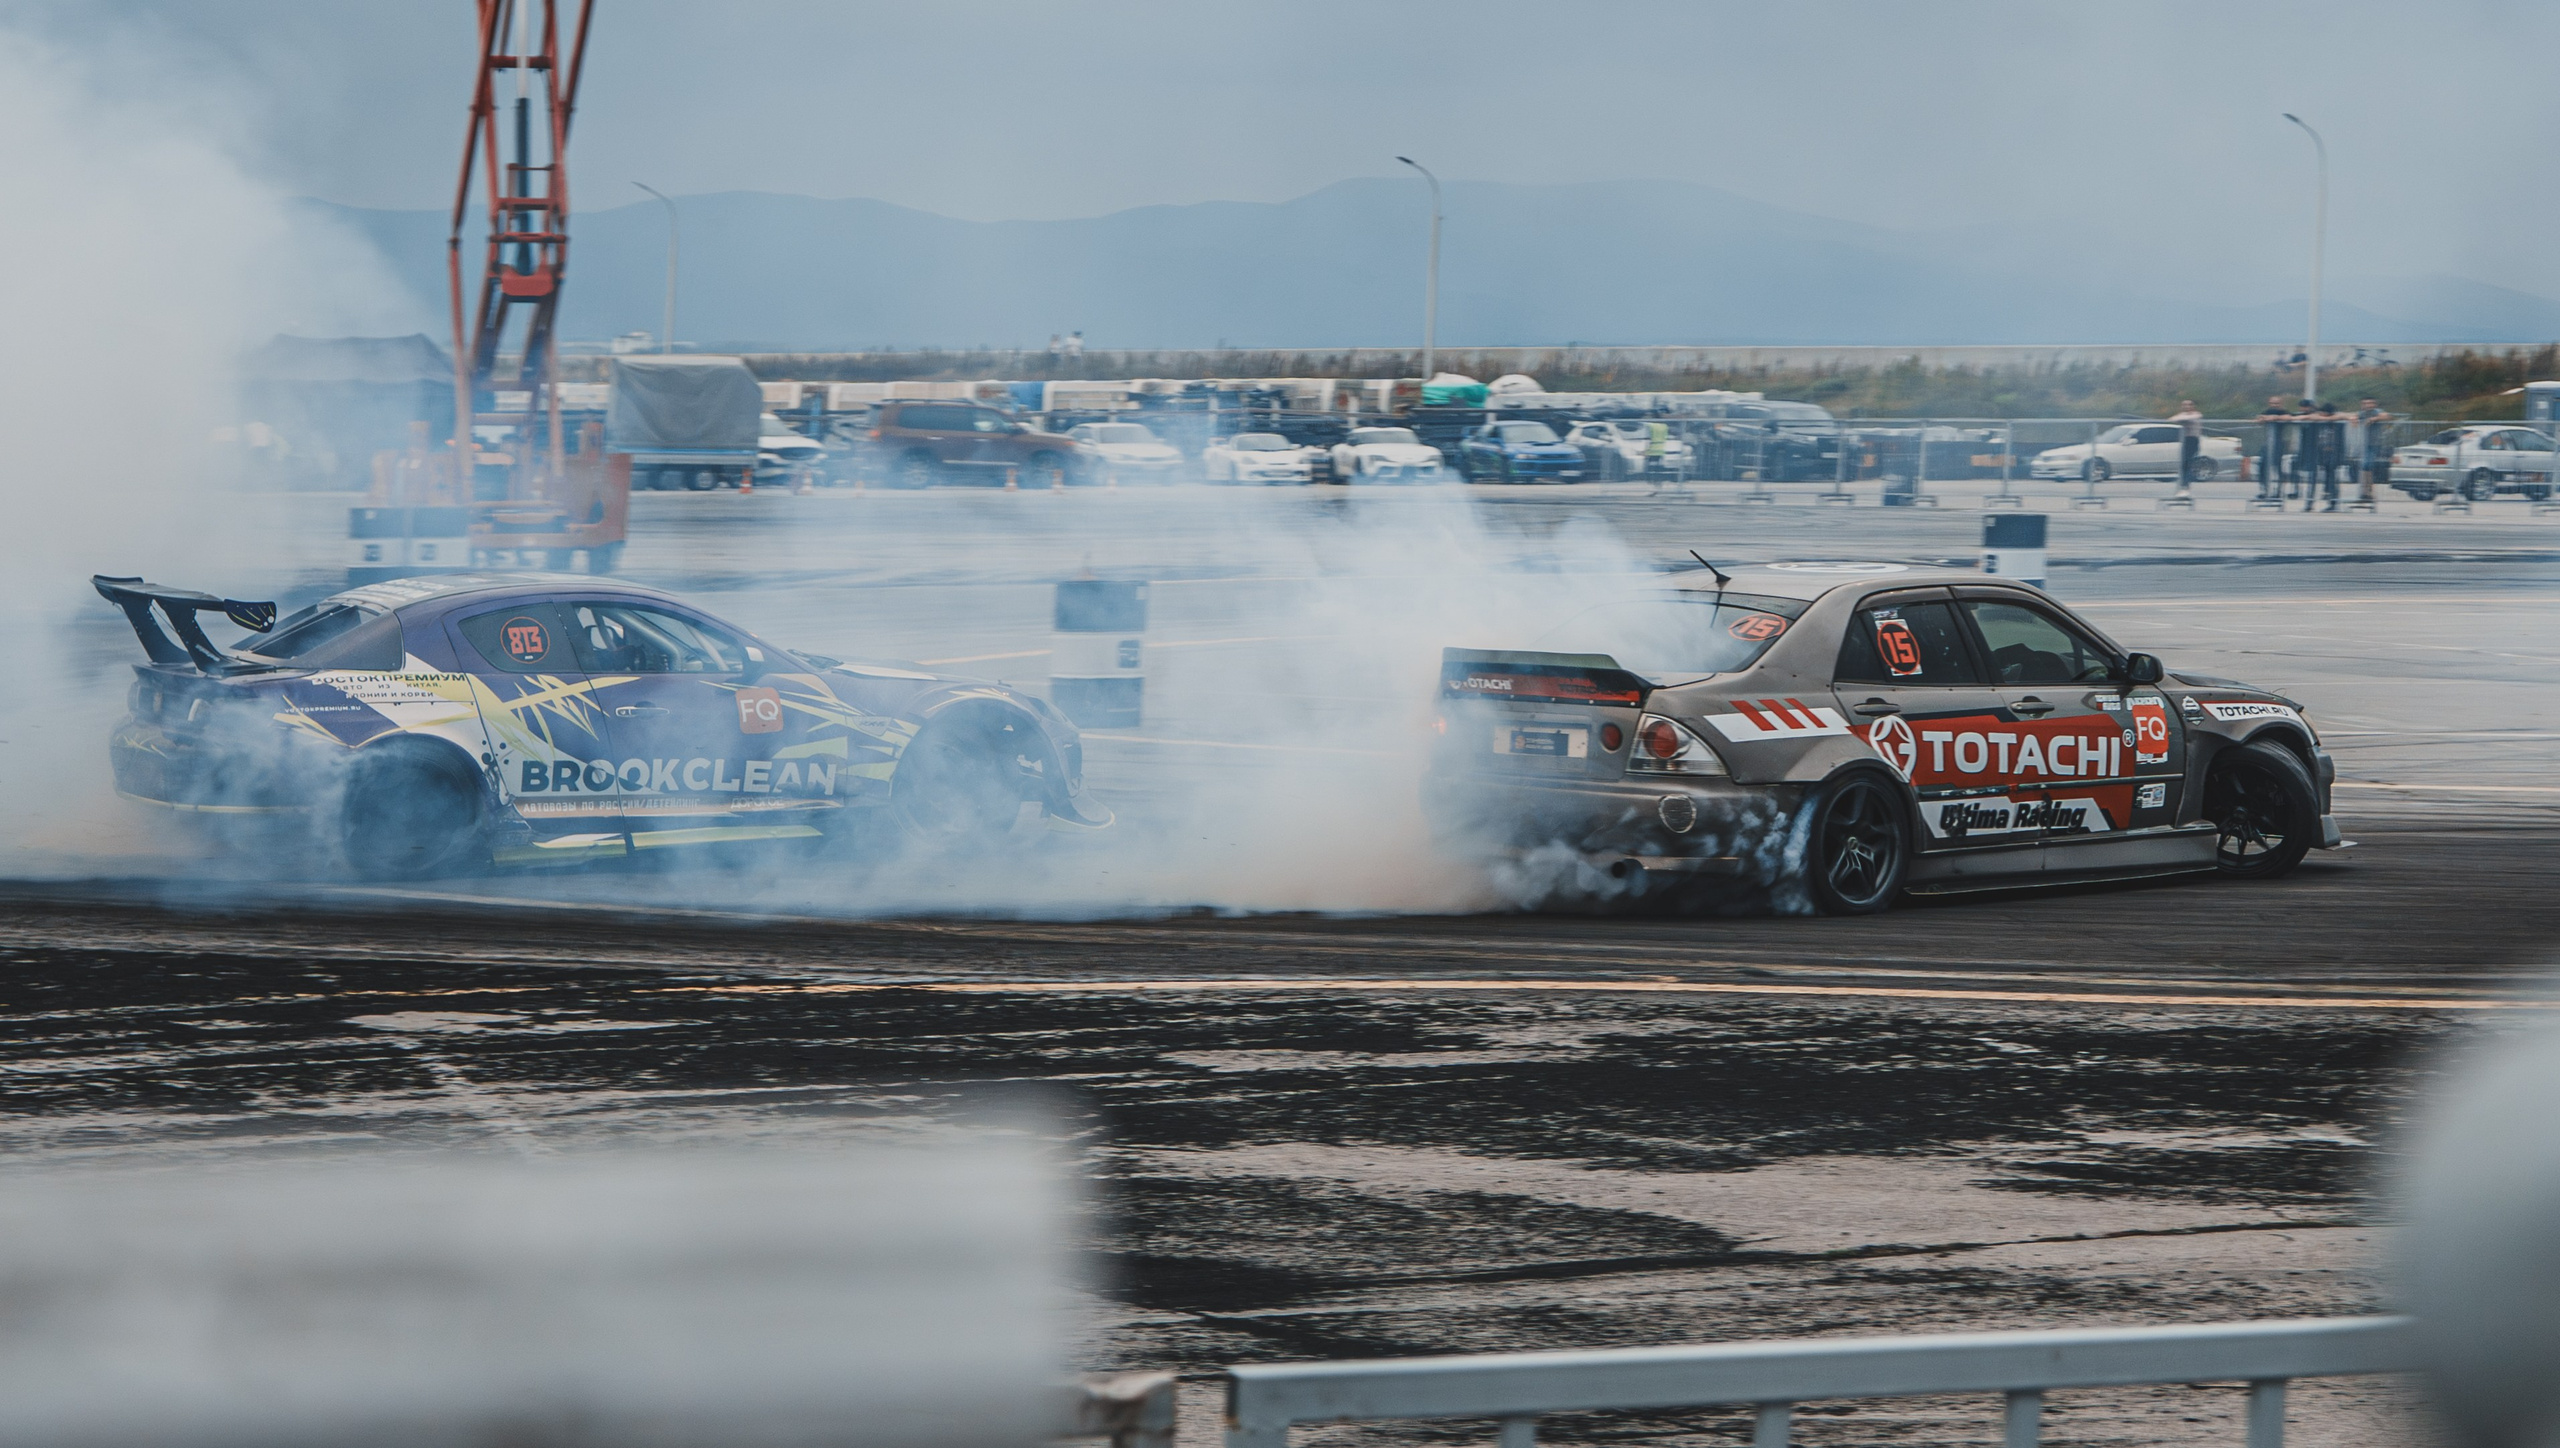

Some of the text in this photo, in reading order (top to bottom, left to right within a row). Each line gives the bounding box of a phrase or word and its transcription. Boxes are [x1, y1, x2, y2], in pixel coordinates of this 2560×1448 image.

[508, 626, 544, 654] 813
[1737, 617, 1781, 638] 15
[1882, 631, 1916, 664] 15
[739, 698, 779, 723] FQ
[2217, 704, 2289, 717] TOTACHI.RU
[2135, 716, 2166, 742] FQ
[1922, 730, 2120, 777] TOTACHI
[521, 757, 837, 796] BROOKCLEAN
[523, 802, 577, 813] АВТОВОЗЫ
[581, 801, 595, 811] ПО
[2012, 801, 2087, 834] Racing
